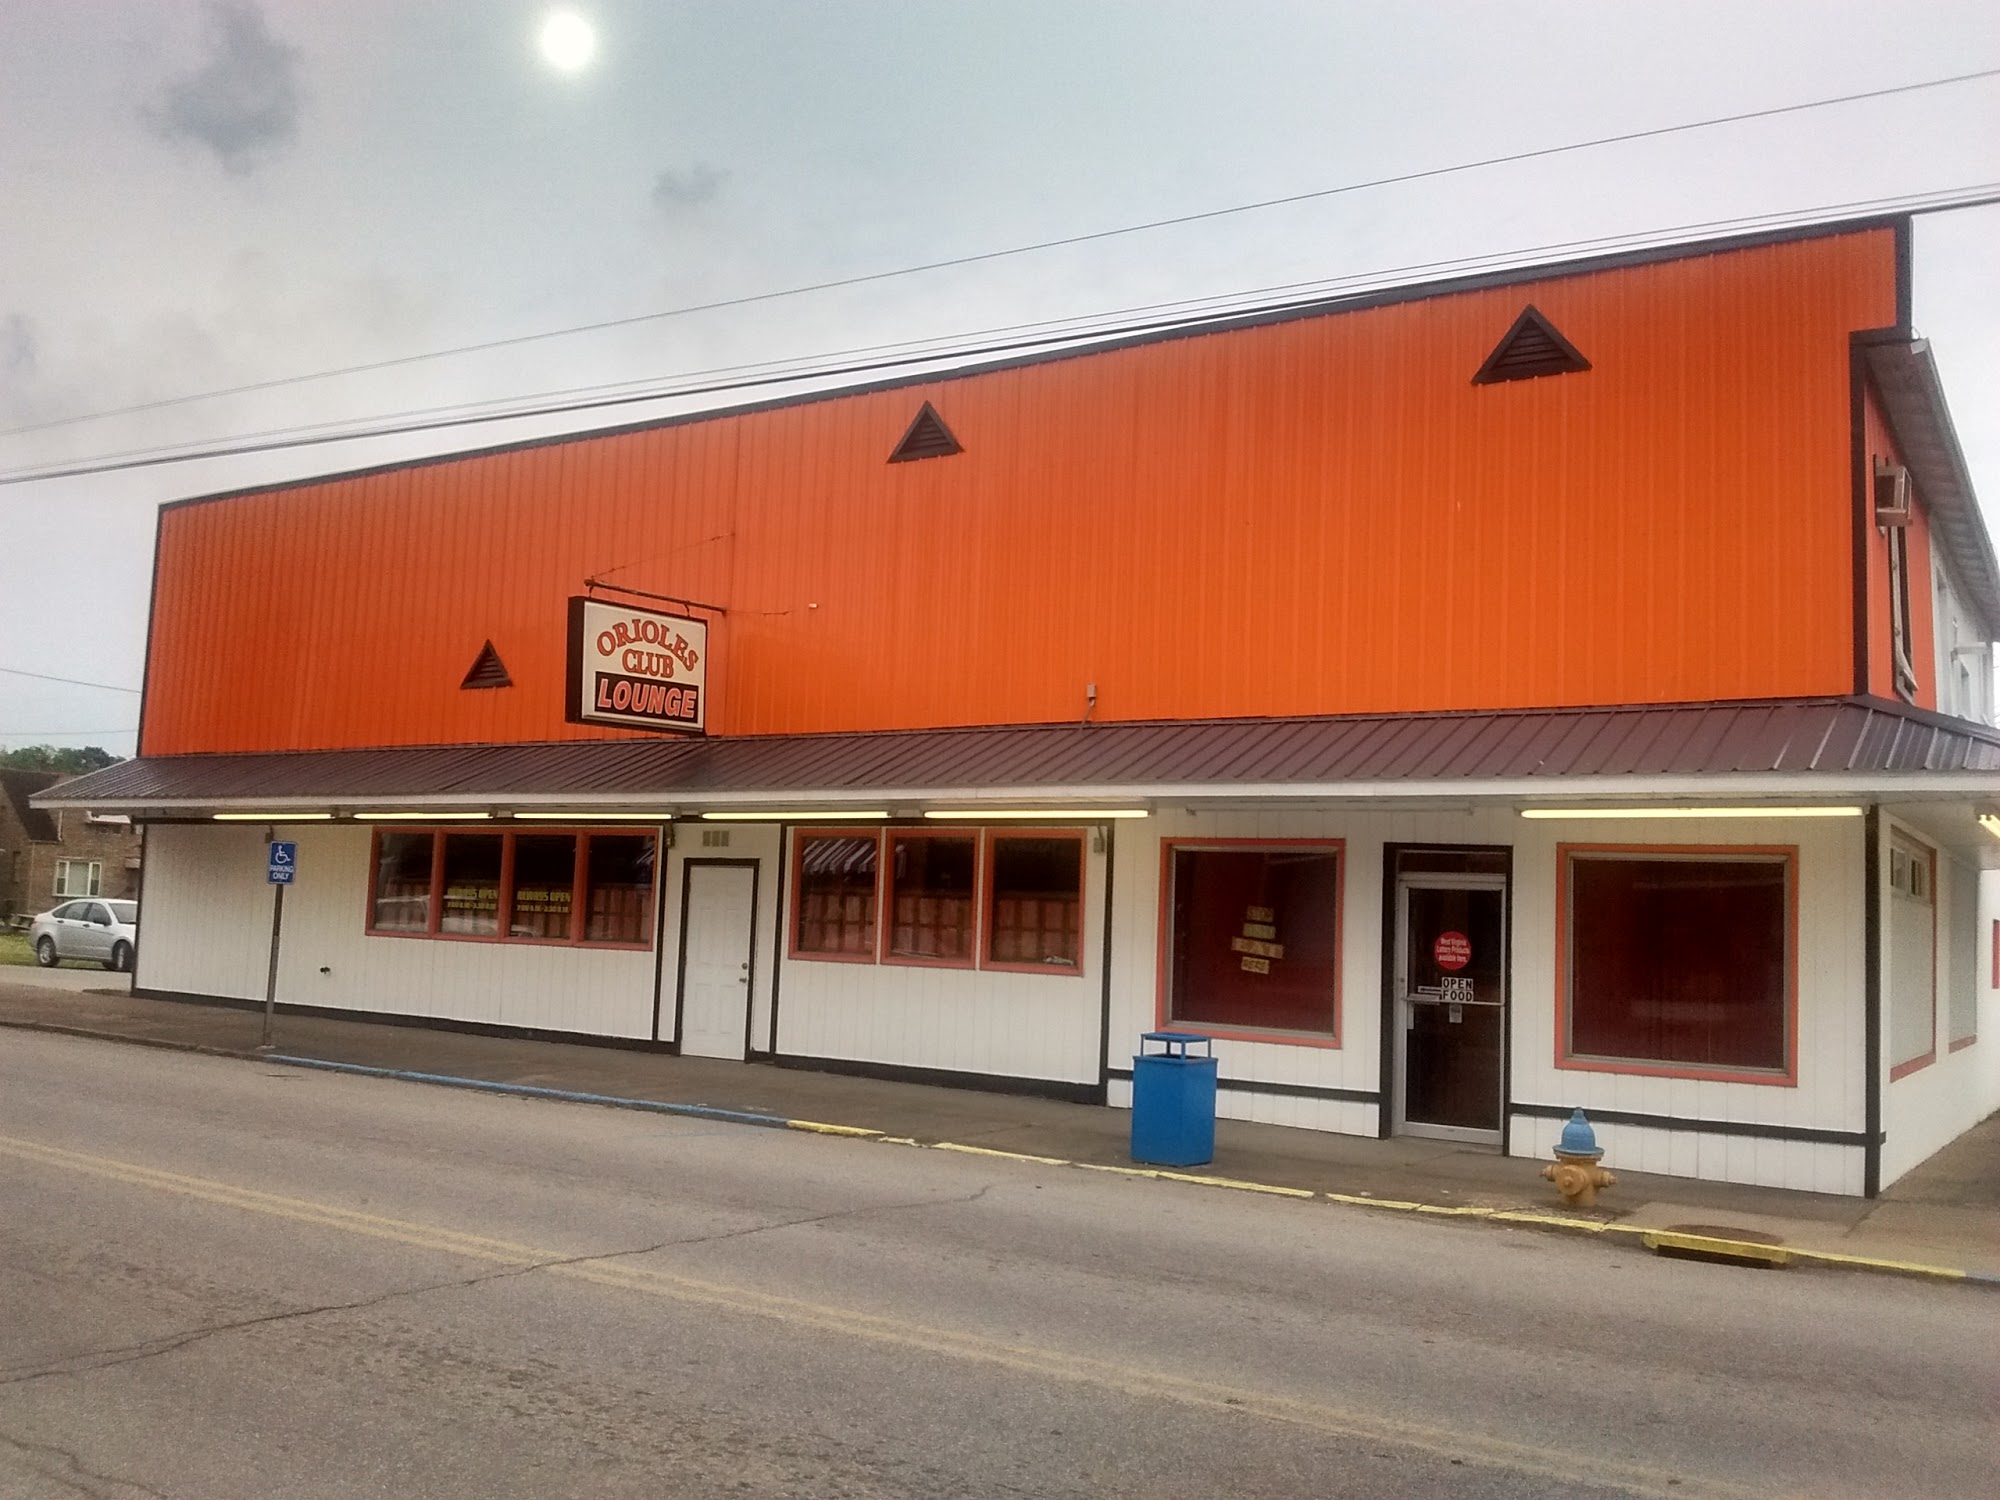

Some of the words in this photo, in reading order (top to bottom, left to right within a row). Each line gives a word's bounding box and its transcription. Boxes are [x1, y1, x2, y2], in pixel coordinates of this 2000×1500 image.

[596, 618, 699, 671] ORIOLES
[622, 648, 674, 679] CLUB
[597, 678, 697, 718] LOUNGE
[273, 871, 290, 880] ONLY
[1442, 978, 1472, 990] OPEN
[1442, 990, 1473, 1002] FOOD
